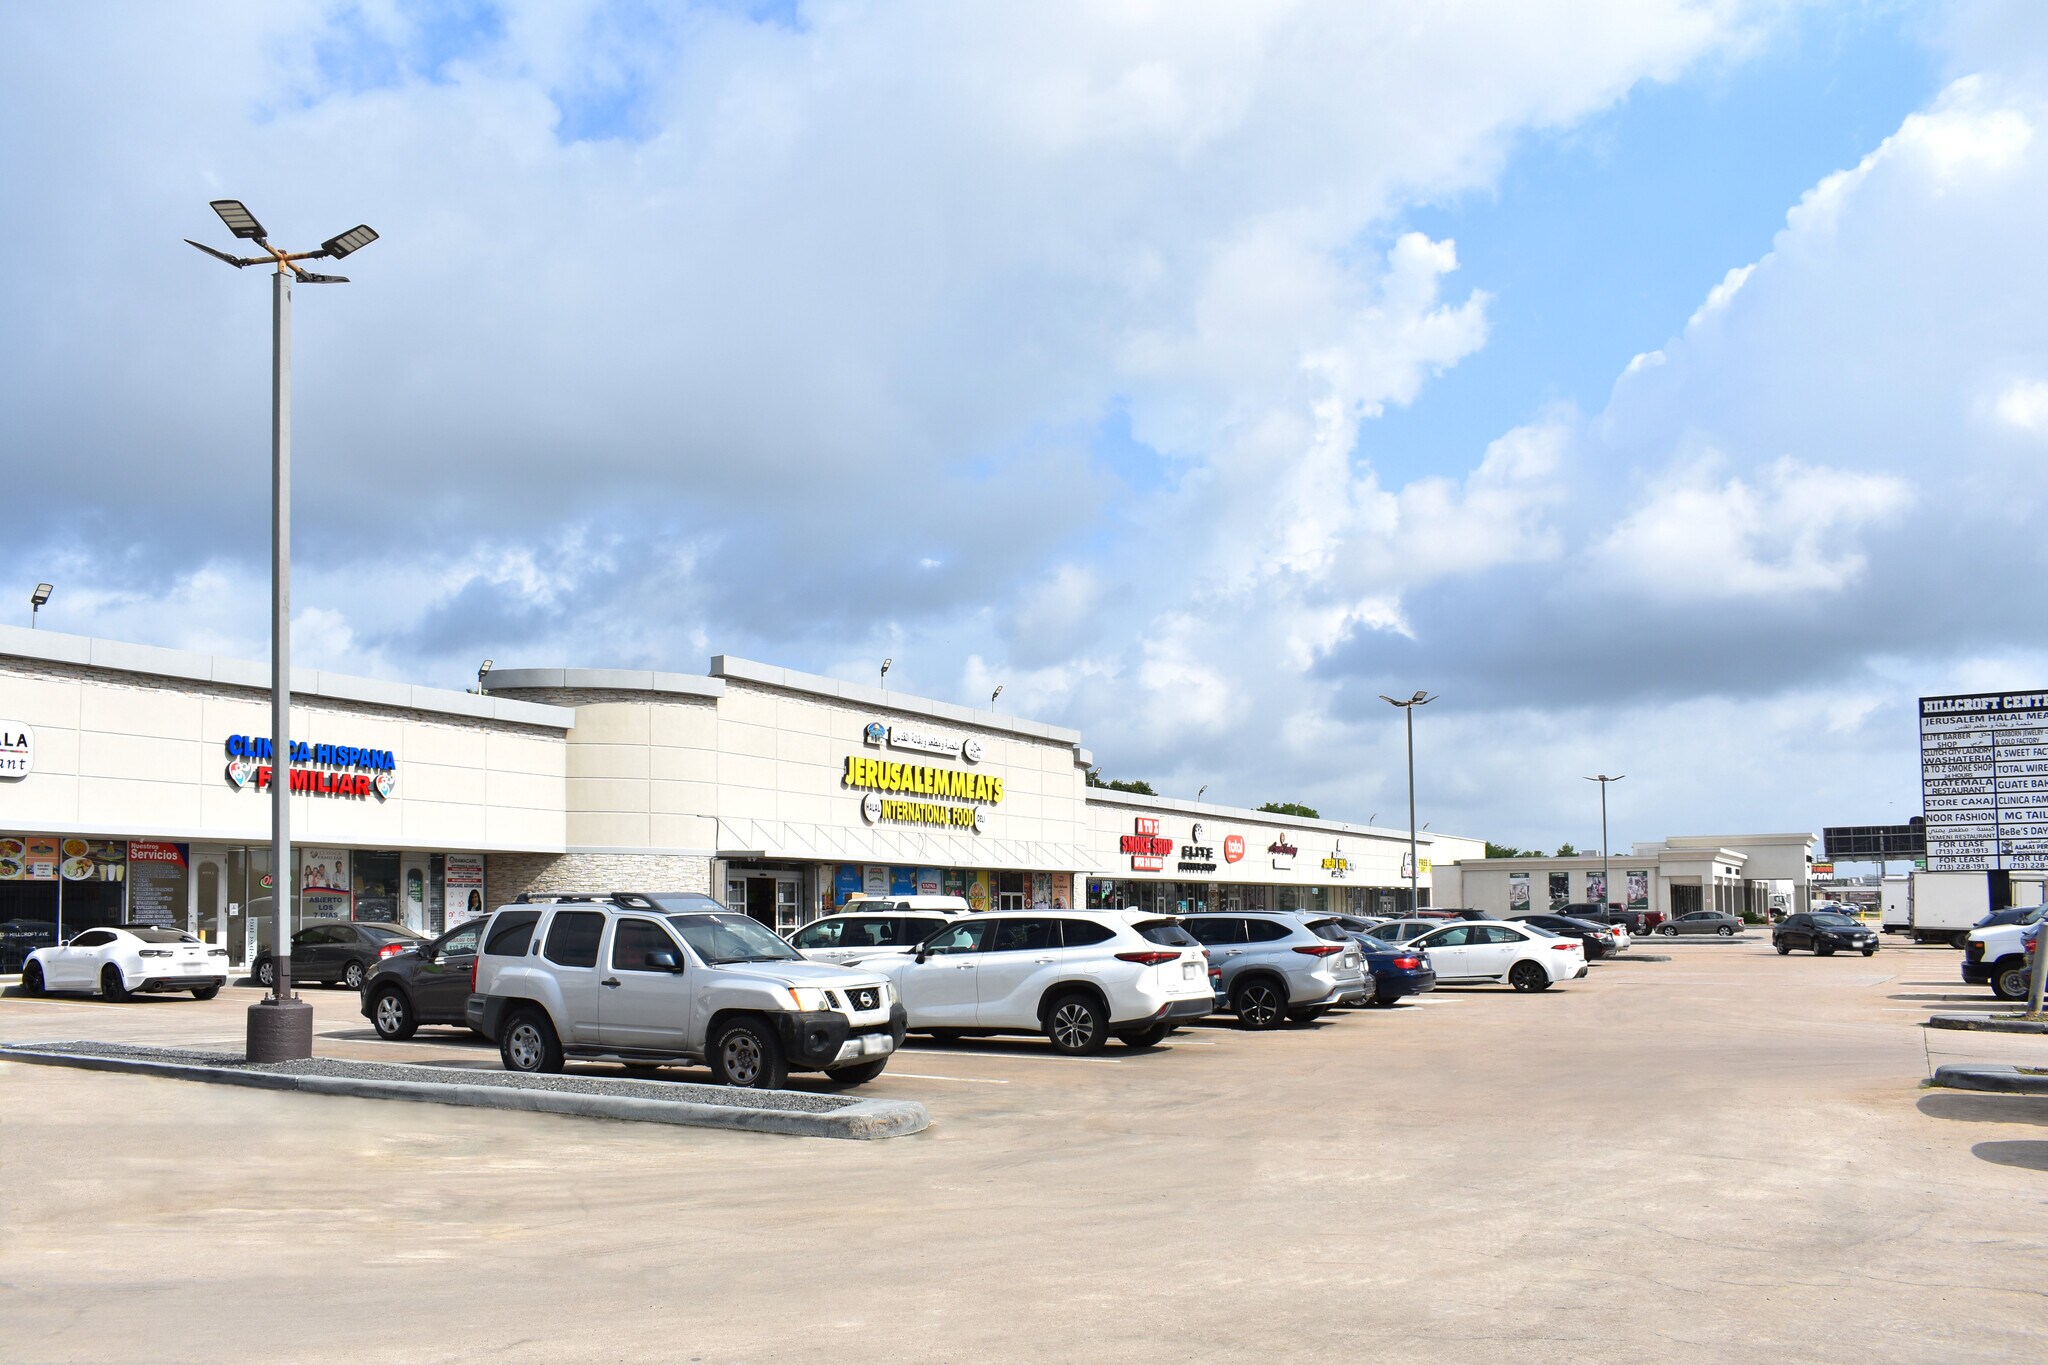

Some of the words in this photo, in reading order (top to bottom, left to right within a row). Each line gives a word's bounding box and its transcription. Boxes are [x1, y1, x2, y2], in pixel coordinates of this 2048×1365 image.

[1923, 697, 1999, 713] HILLCROFT
[1926, 716, 1985, 726] JERUSALEM
[1988, 714, 2023, 722] HALAL
[1995, 730, 2021, 738] DEARBORN
[2022, 729, 2044, 737] JEWELRY
[0, 732, 28, 747] LA
[228, 734, 310, 762] CLINCA
[317, 743, 396, 770] HISPANA
[1962, 747, 1992, 755] LAUNDRY
[1996, 750, 2002, 758] A
[2004, 749, 2030, 757] SWEET
[1924, 755, 1992, 764] WASHATERIA
[1997, 765, 2024, 773] TOTAL
[258, 766, 370, 796] FMILIAR
[1925, 779, 1993, 787] GUATEMALA
[1997, 780, 2028, 789] GUATE
[1932, 786, 1986, 794] RESTAURANT
[1961, 798, 1994, 806] CAXAJ
[1998, 796, 2029, 805] CLINICA
[882, 800, 950, 824] INTERNATIONAL
[953, 808, 974, 827] FOOD
[1926, 813, 1952, 822] NOOR
[1955, 813, 1995, 821] FASHION
[2005, 812, 2022, 820] MG
[1138, 819, 1143, 832] A
[1144, 819, 1153, 833] TO
[1154, 820, 1159, 834] Z
[2000, 827, 2028, 835] BeBe'S
[1122, 836, 1150, 853] SMOKE
[1152, 838, 1173, 855] SHOP
[1228, 839, 1243, 853] total
[131, 849, 177, 860] Servicios
[1182, 846, 1213, 858] ELITE
